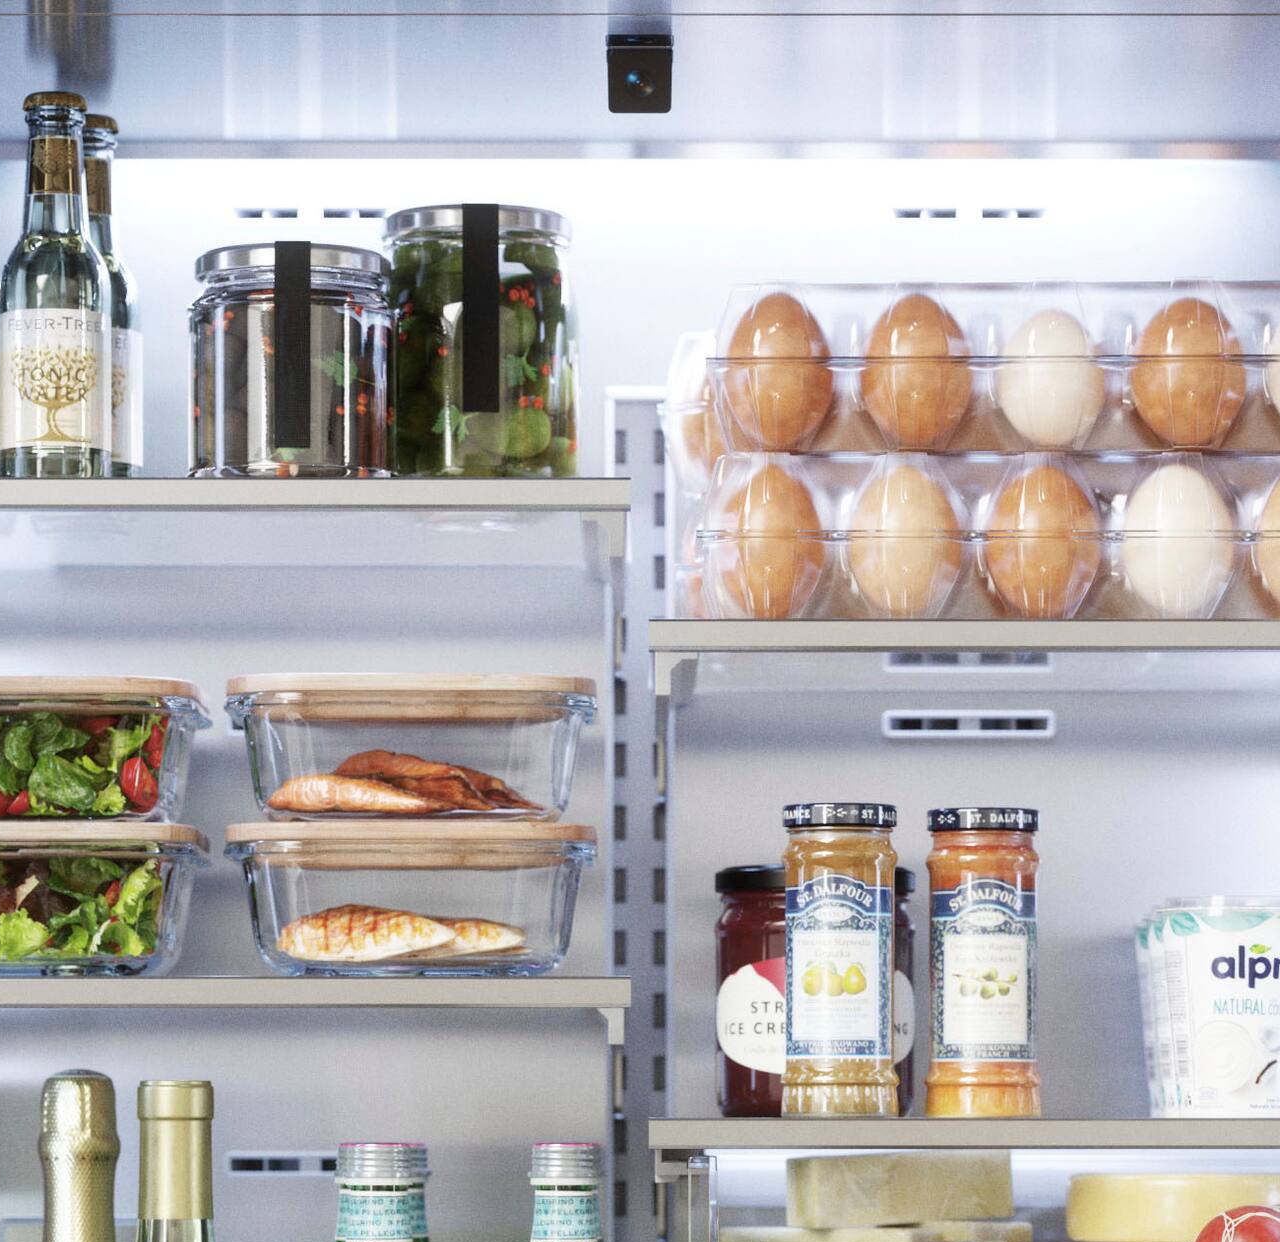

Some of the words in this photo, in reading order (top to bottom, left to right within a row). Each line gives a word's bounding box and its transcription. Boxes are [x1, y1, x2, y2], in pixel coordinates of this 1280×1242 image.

[8, 316, 102, 332] FEVER-TREE
[20, 367, 86, 382] TONIC
[20, 386, 87, 402] WATER
[989, 813, 1033, 824] DALFOUR
[812, 882, 873, 908] DALFOUR
[967, 887, 1023, 912] DALFOUR
[751, 1001, 784, 1014] STR
[1213, 998, 1265, 1016] NATURAL
[724, 1022, 744, 1035] ICE
[753, 1022, 786, 1035] CRE
